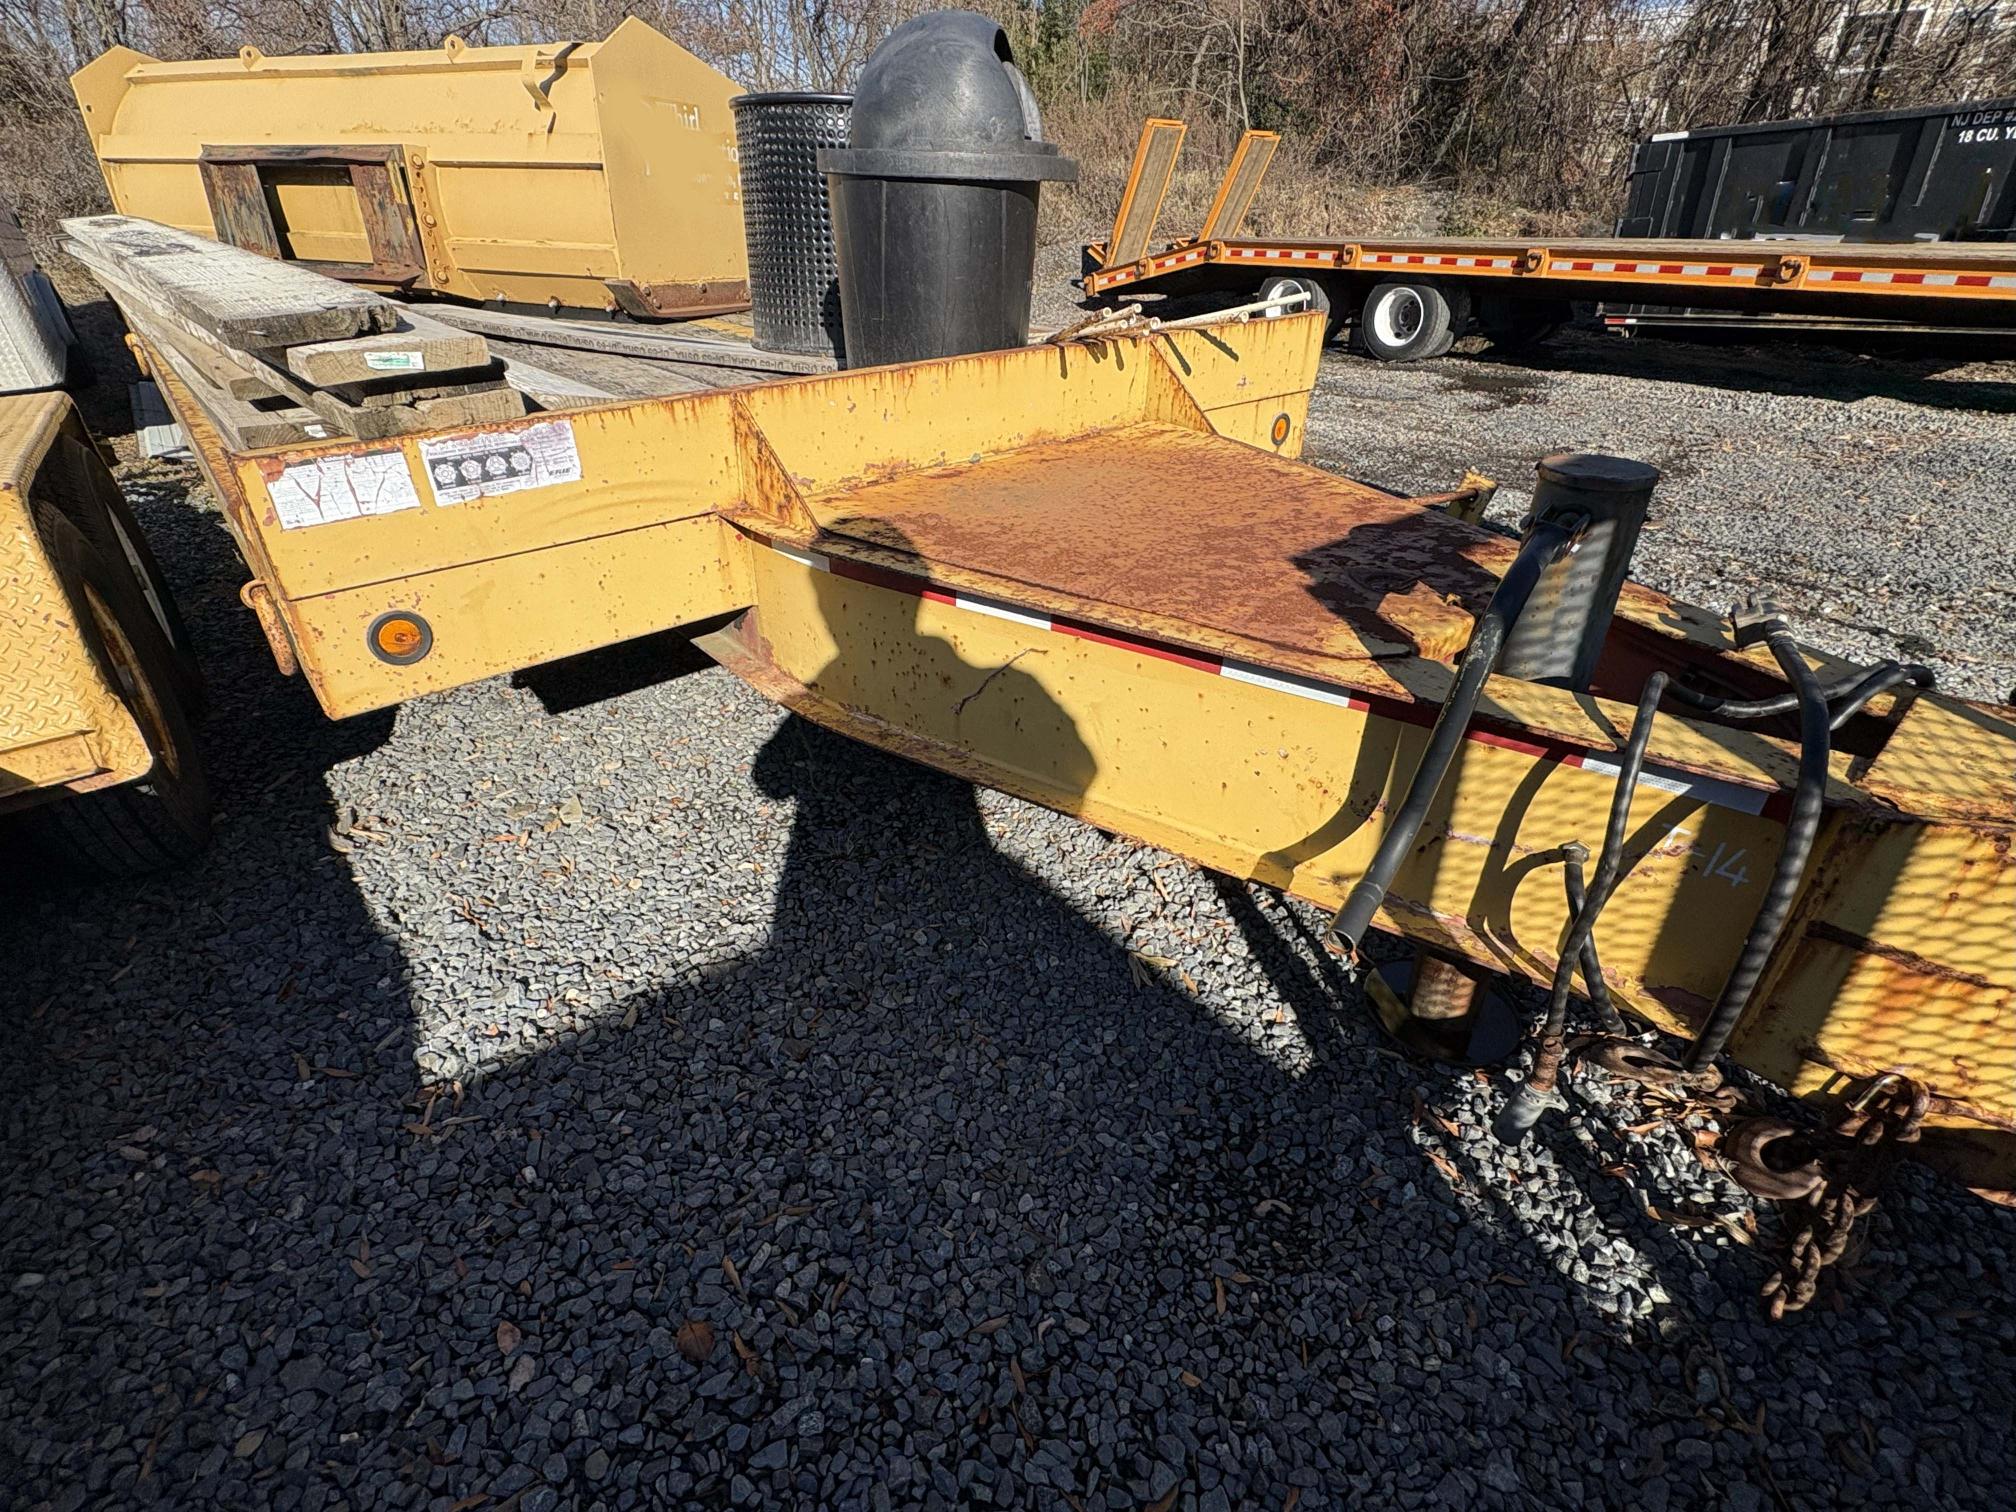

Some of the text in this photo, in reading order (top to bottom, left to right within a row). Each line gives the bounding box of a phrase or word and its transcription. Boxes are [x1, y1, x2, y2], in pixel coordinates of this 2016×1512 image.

[1952, 113, 1971, 127] NJ
[1972, 111, 2003, 124] DEP
[1958, 129, 1974, 143] 18
[1976, 127, 1999, 142] CU.
